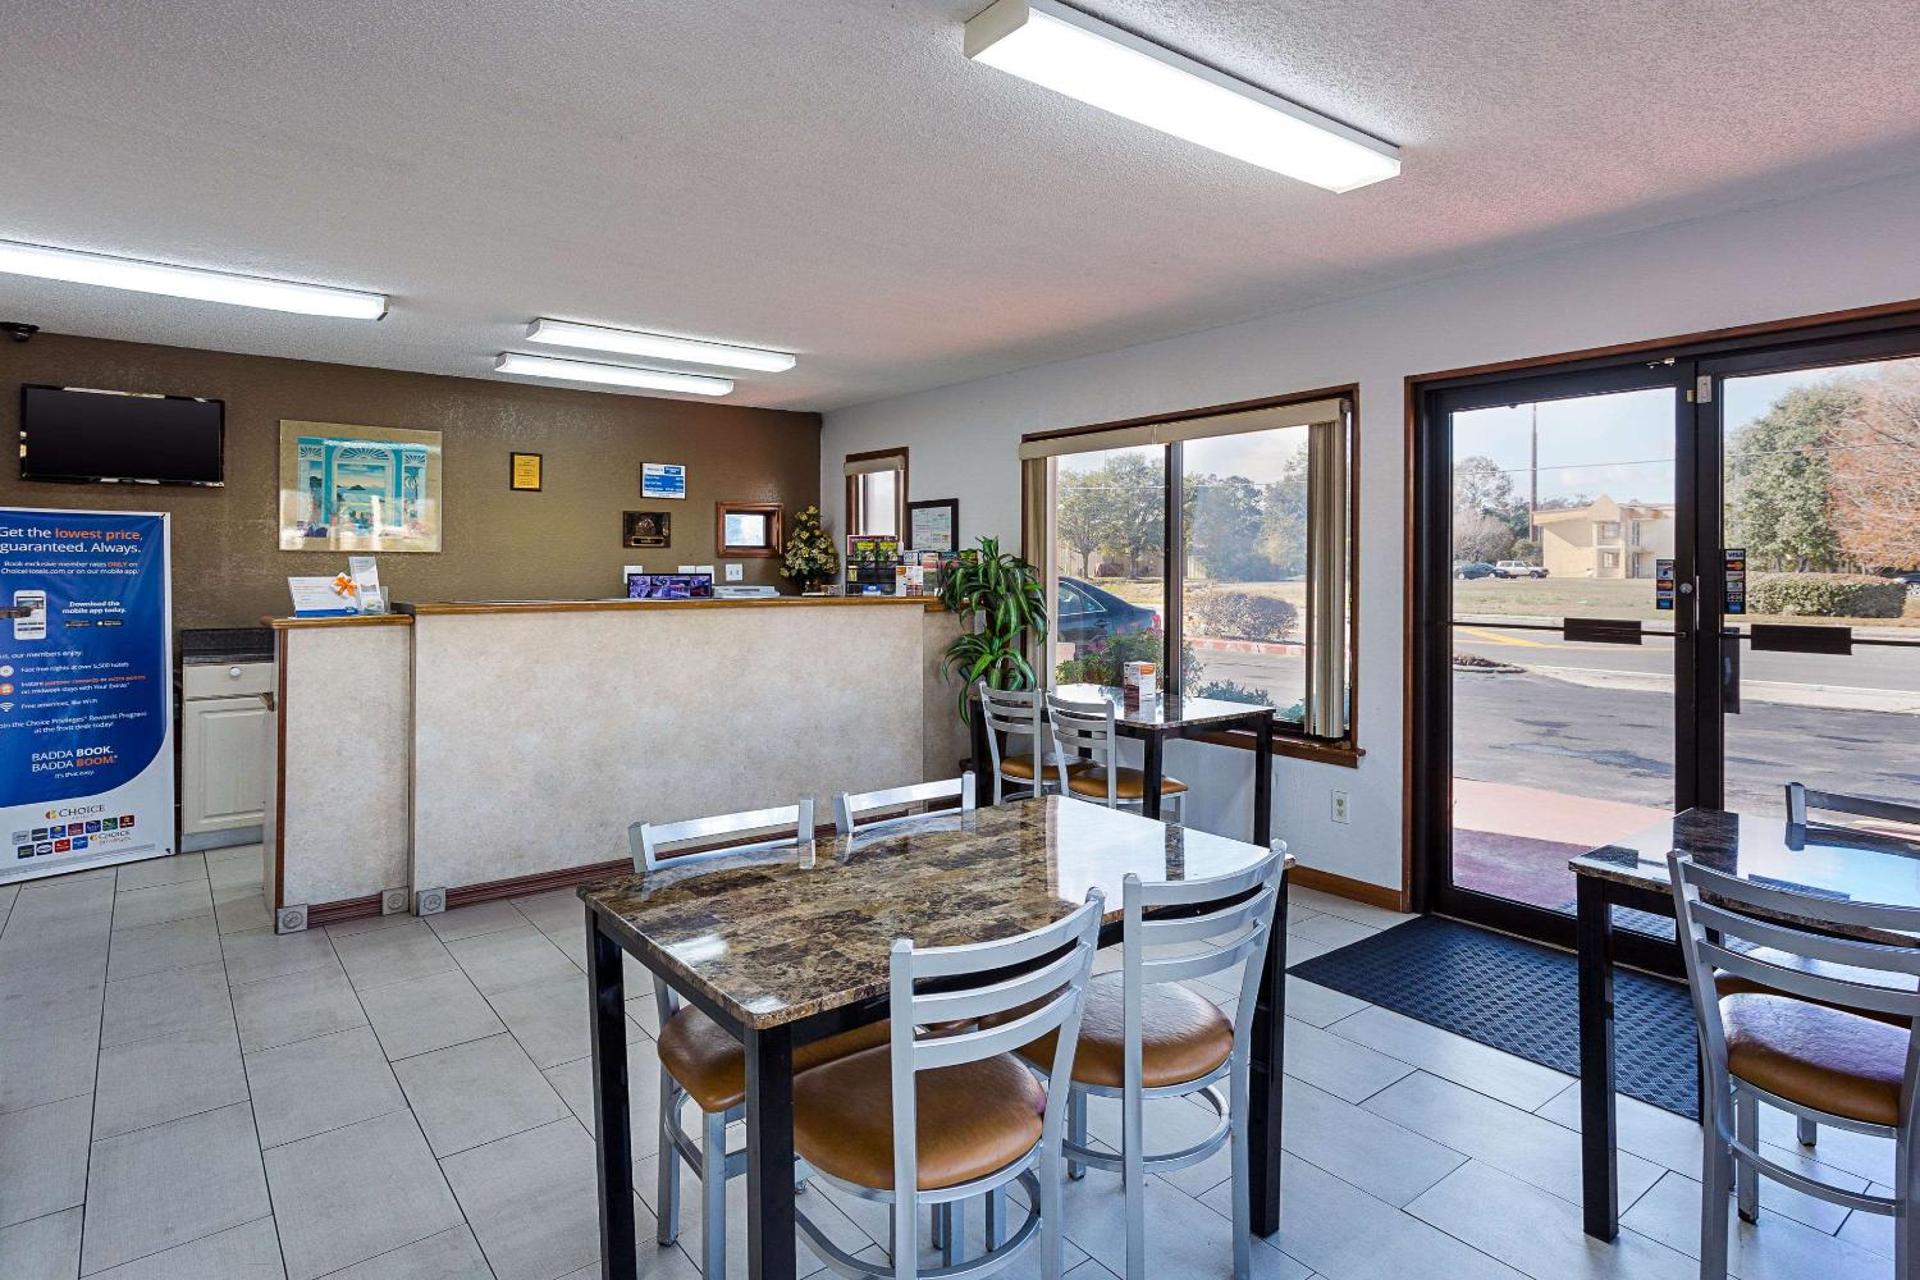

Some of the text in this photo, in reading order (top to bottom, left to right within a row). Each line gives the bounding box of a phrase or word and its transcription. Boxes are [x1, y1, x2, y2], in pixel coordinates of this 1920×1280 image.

[0, 527, 143, 541] Get the lowest price,
[0, 542, 141, 555] guaranteed. Always.
[26, 650, 61, 658] members
[32, 745, 114, 762] BADDA BOOK.
[32, 760, 74, 773] BADDA
[59, 805, 105, 817] CHOICE
